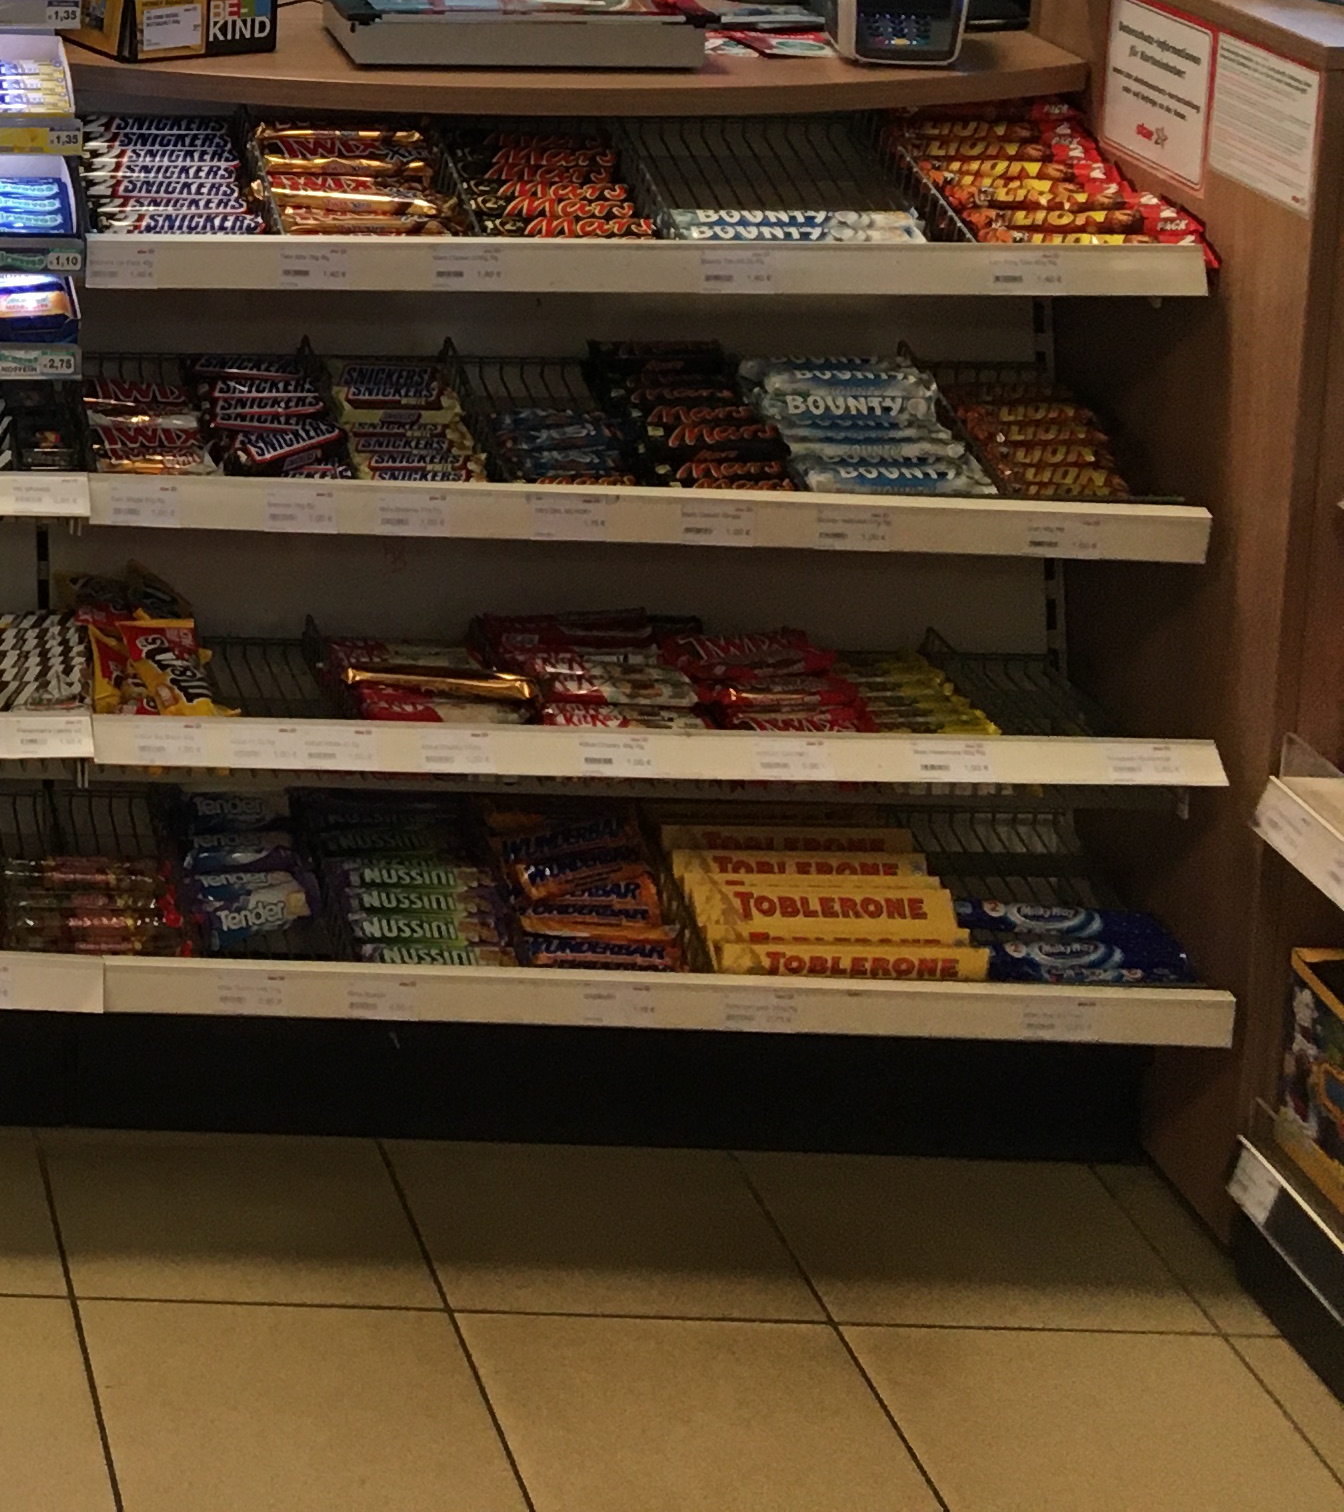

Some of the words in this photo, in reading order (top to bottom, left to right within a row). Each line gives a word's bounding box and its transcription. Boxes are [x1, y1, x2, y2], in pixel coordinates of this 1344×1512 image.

[209, 17, 271, 42] KIND
[124, 180, 240, 197] SNICKERS
[144, 213, 262, 233] SNICKERS
[1021, 210, 1108, 227] LION
[785, 394, 905, 416] BOUNTY
[217, 900, 287, 931] Tender
[734, 892, 928, 920] TOBLERONE
[767, 951, 959, 978] TOBLERONE
